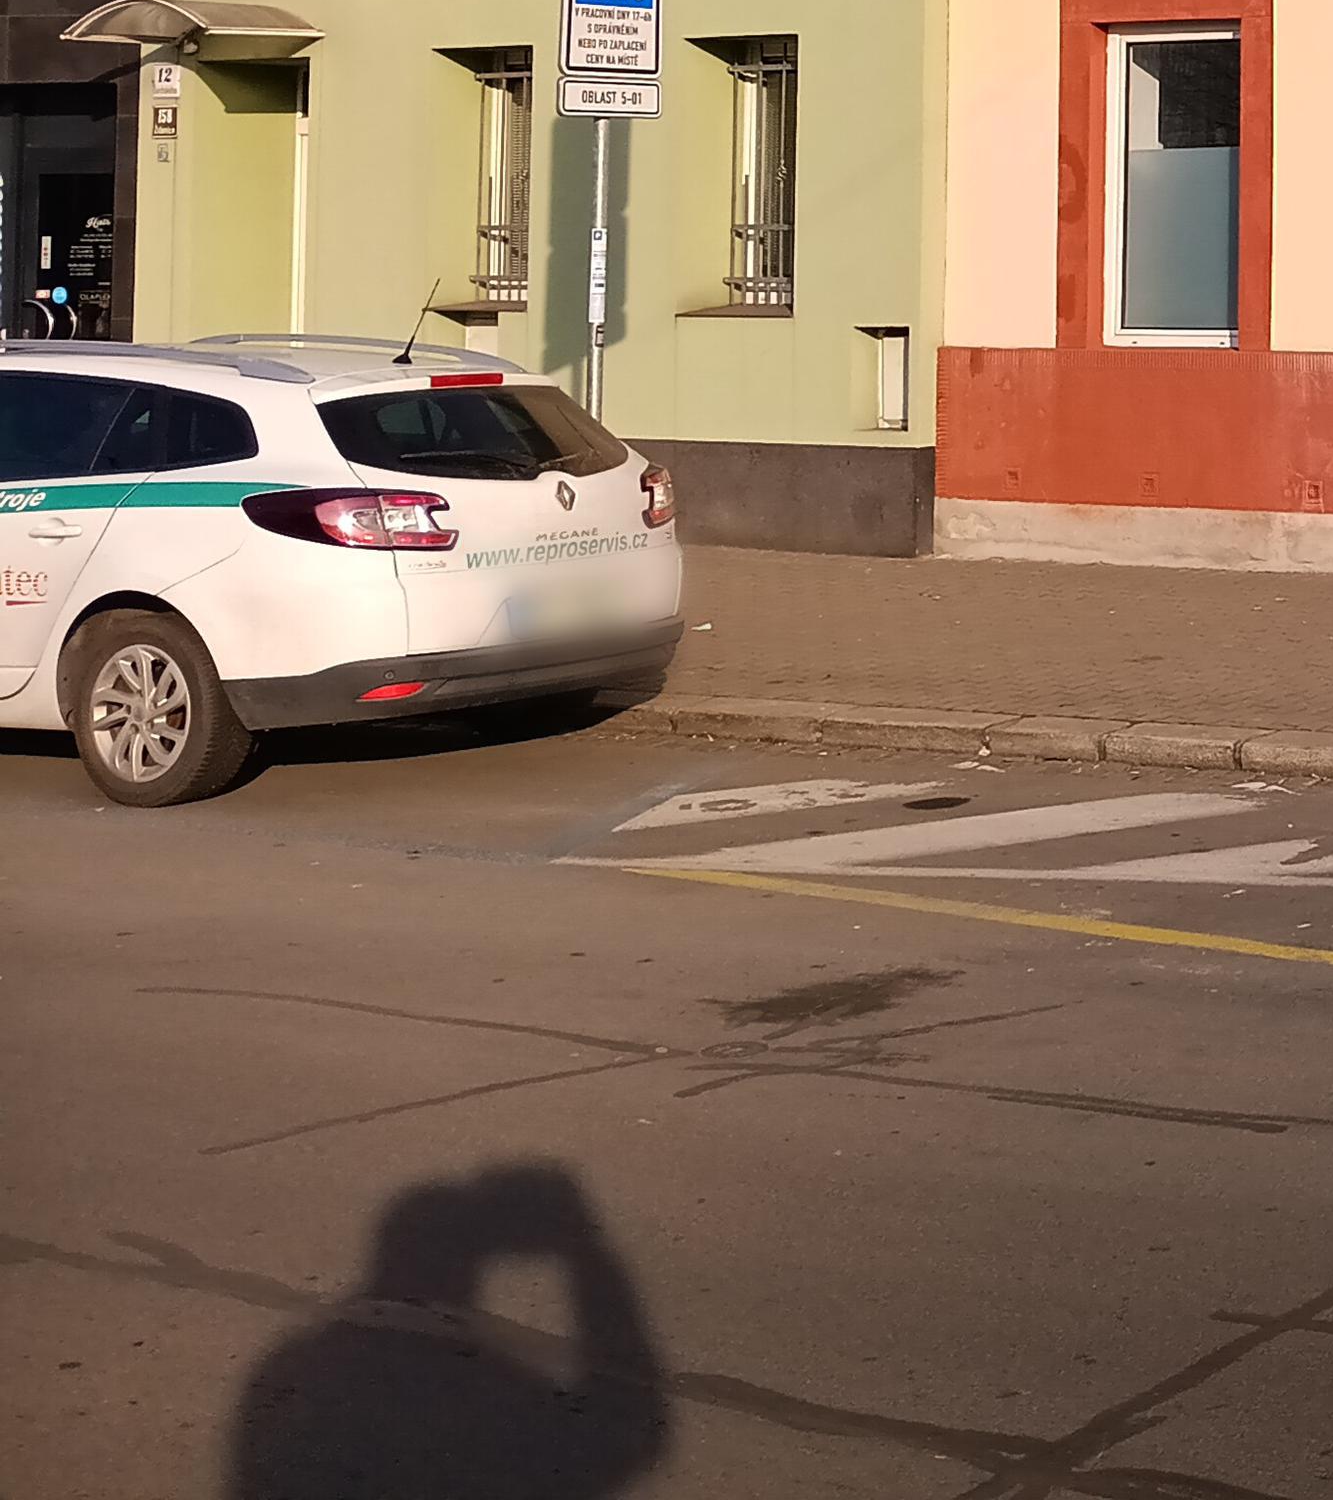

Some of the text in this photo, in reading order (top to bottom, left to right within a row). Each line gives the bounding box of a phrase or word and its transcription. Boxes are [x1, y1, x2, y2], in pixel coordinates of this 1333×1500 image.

[158, 67, 172, 82] 12
[582, 90, 642, 105] OBLAST 5-01
[0, 489, 46, 511] roje
[466, 532, 649, 569] www.reproservis.cz
[0, 566, 48, 597] tec
